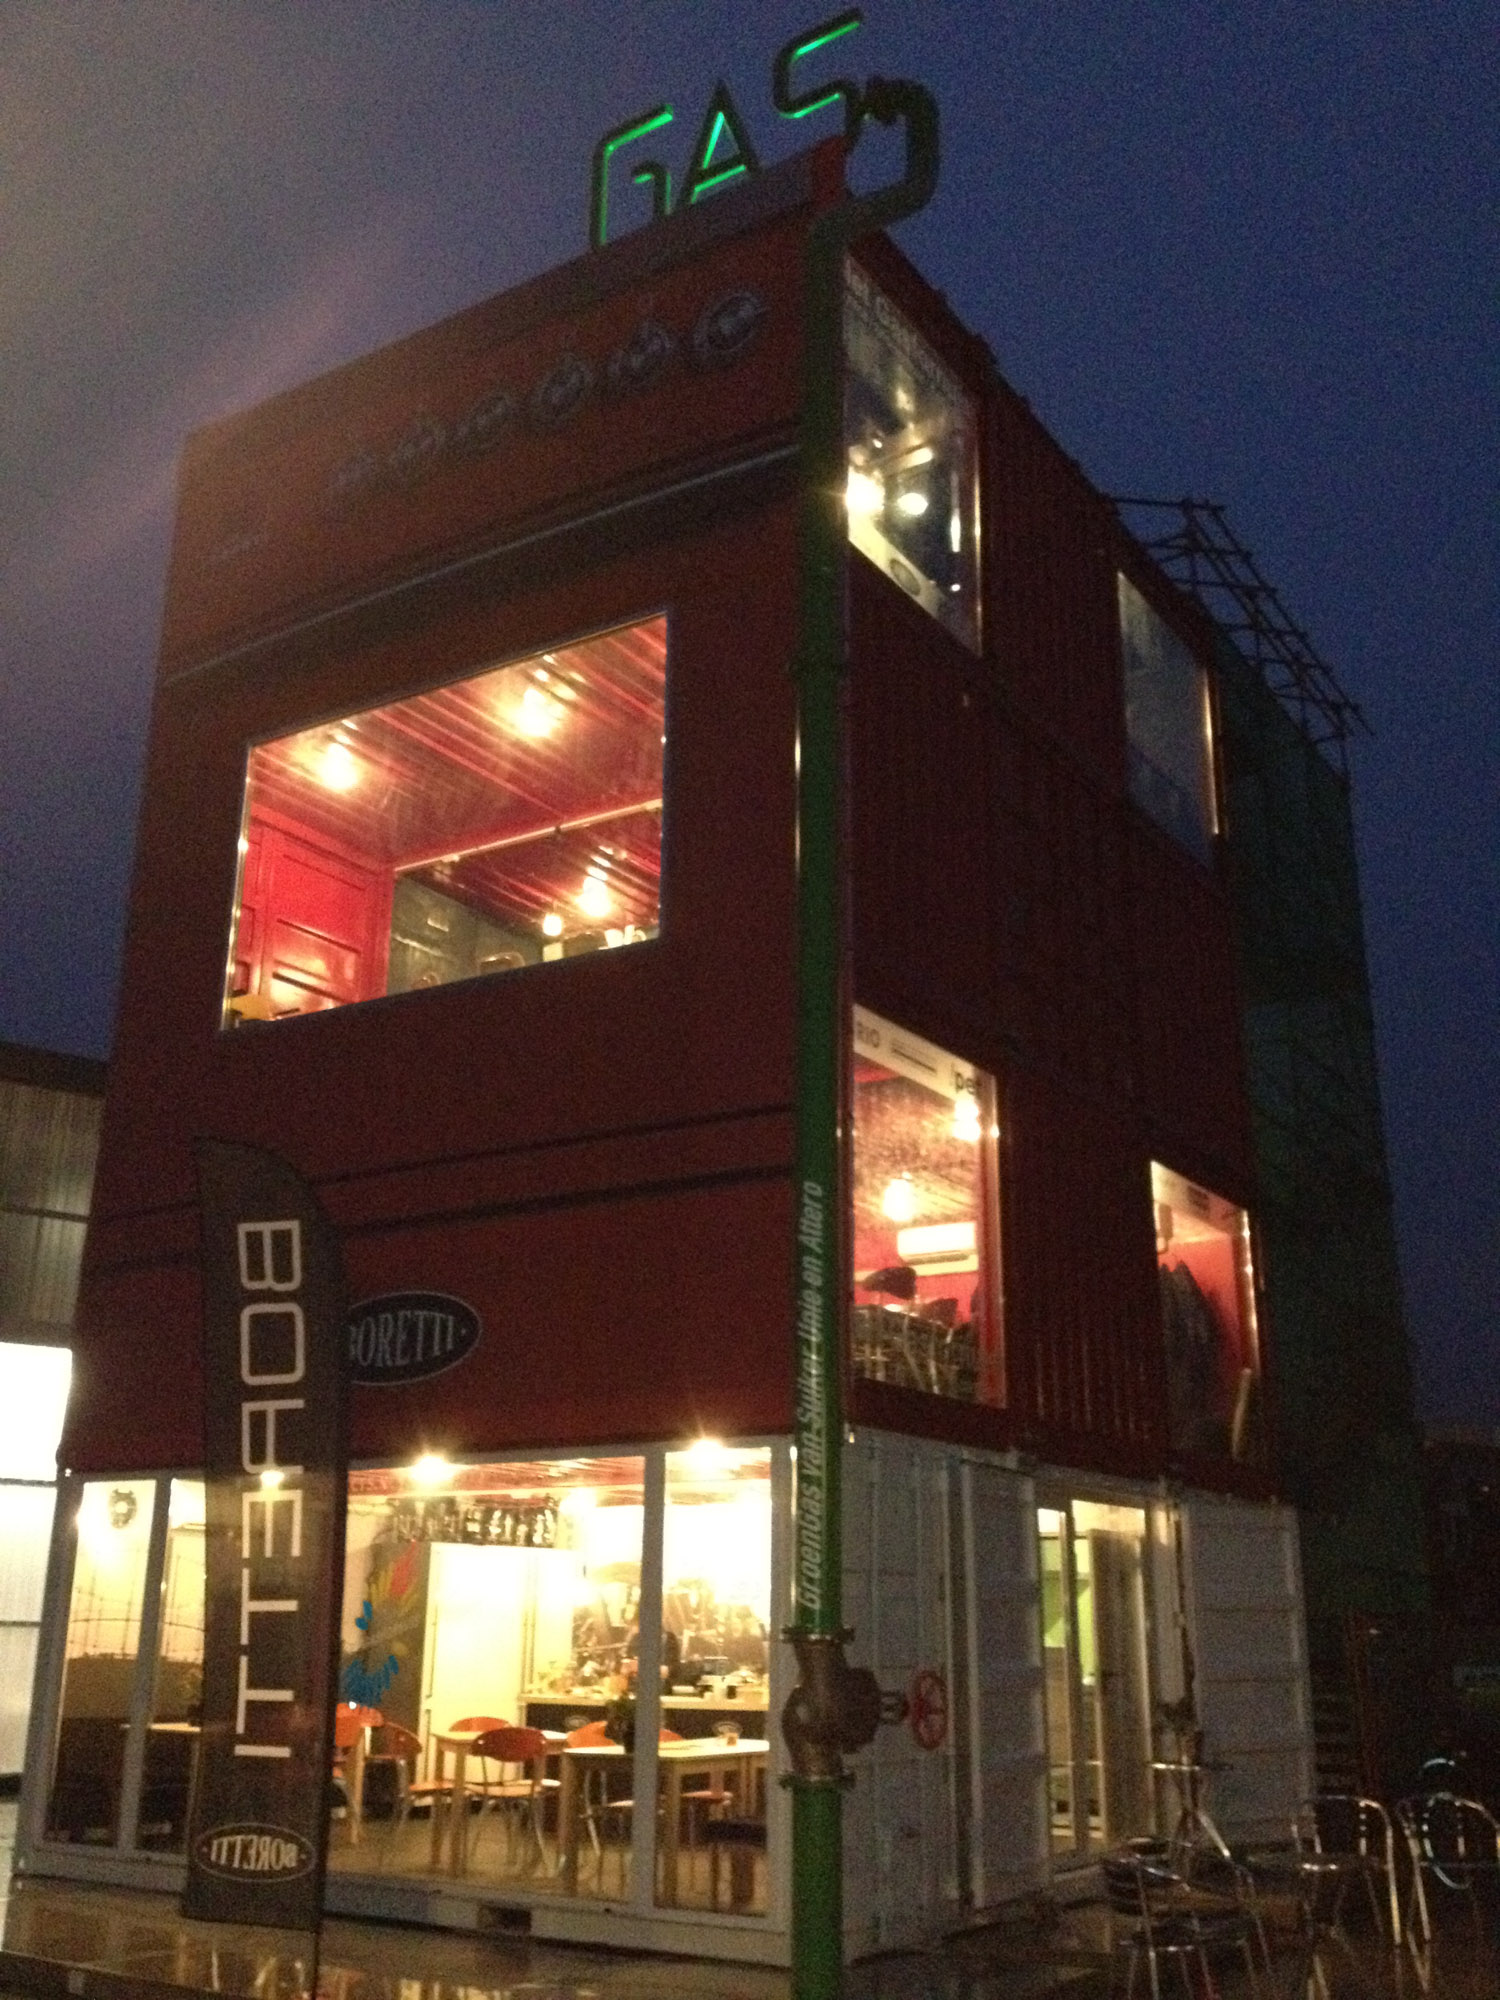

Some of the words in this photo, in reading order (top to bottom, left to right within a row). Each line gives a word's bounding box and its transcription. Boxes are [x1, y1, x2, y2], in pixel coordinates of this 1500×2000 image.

[590, 9, 864, 248] GAS
[798, 1181, 824, 1254] Attero
[801, 1255, 824, 1287] en
[797, 1344, 825, 1424] Suiker
[234, 1219, 305, 1758] BORETTI
[801, 1431, 823, 1477] van
